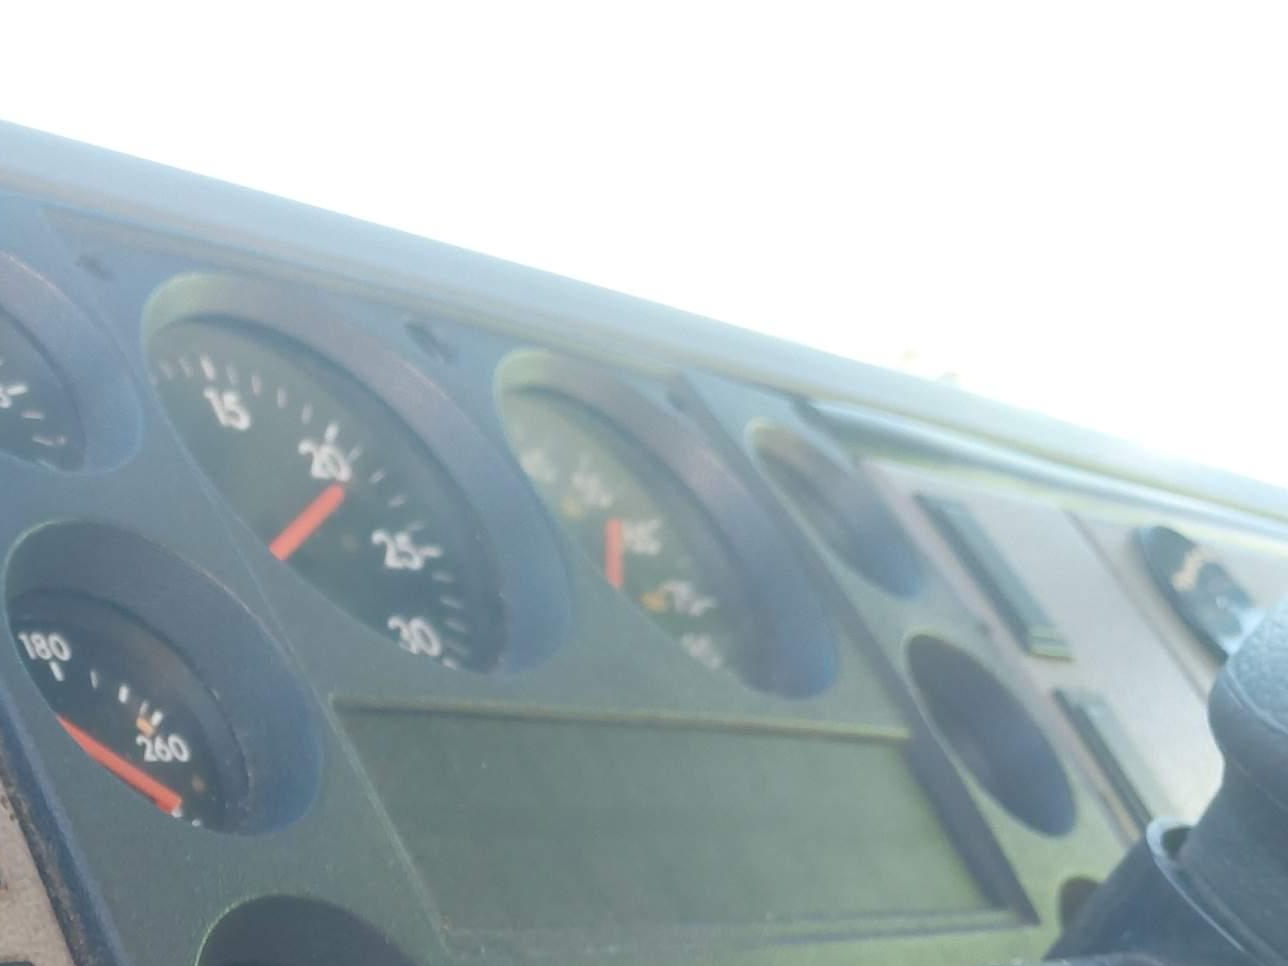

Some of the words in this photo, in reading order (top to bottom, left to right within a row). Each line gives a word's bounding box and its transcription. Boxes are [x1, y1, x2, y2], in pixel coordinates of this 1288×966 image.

[203, 387, 251, 431] 15
[298, 438, 352, 483] 20
[372, 529, 425, 571] 25
[18, 632, 72, 663] 180
[387, 615, 443, 657] 30
[136, 734, 190, 763] 260
